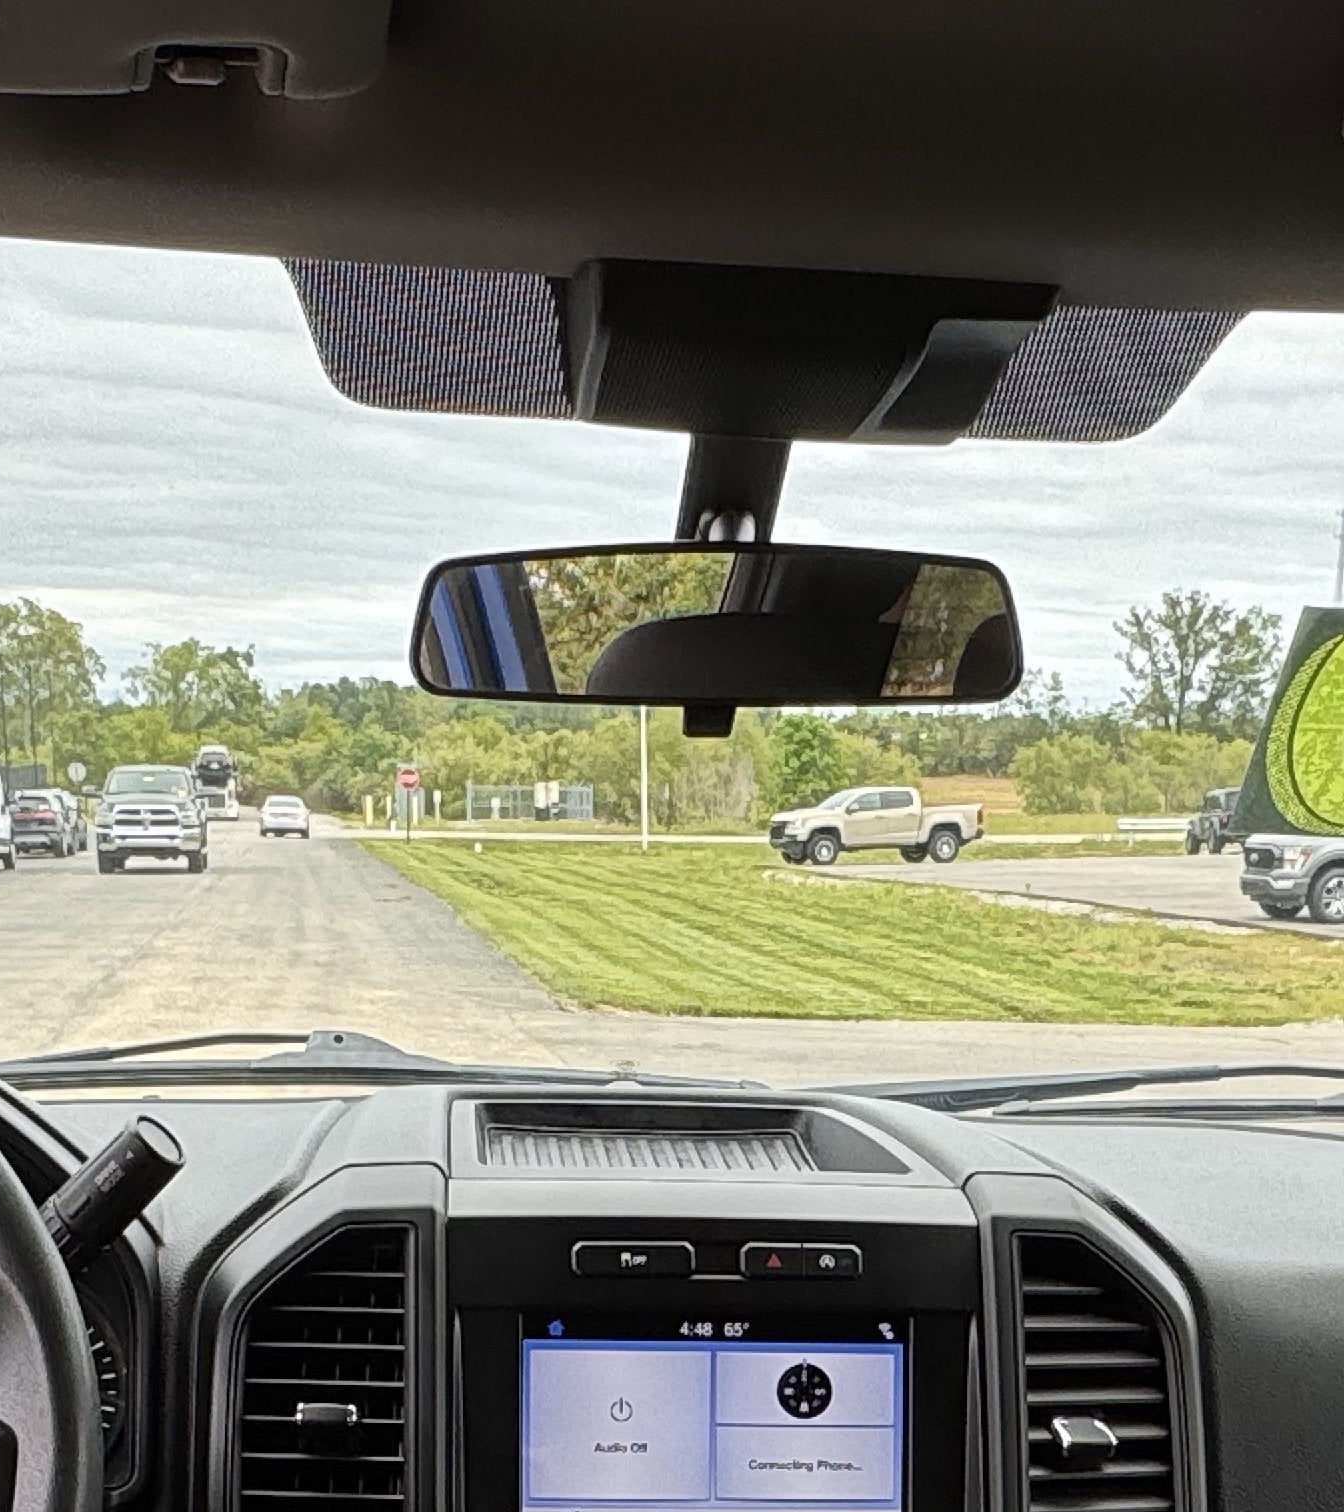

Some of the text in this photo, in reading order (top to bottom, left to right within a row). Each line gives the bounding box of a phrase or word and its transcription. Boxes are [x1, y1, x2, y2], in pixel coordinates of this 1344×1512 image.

[679, 1321, 714, 1337] 4:48
[594, 1442, 648, 1454] Audio Off
[748, 1458, 814, 1473] Connecting
